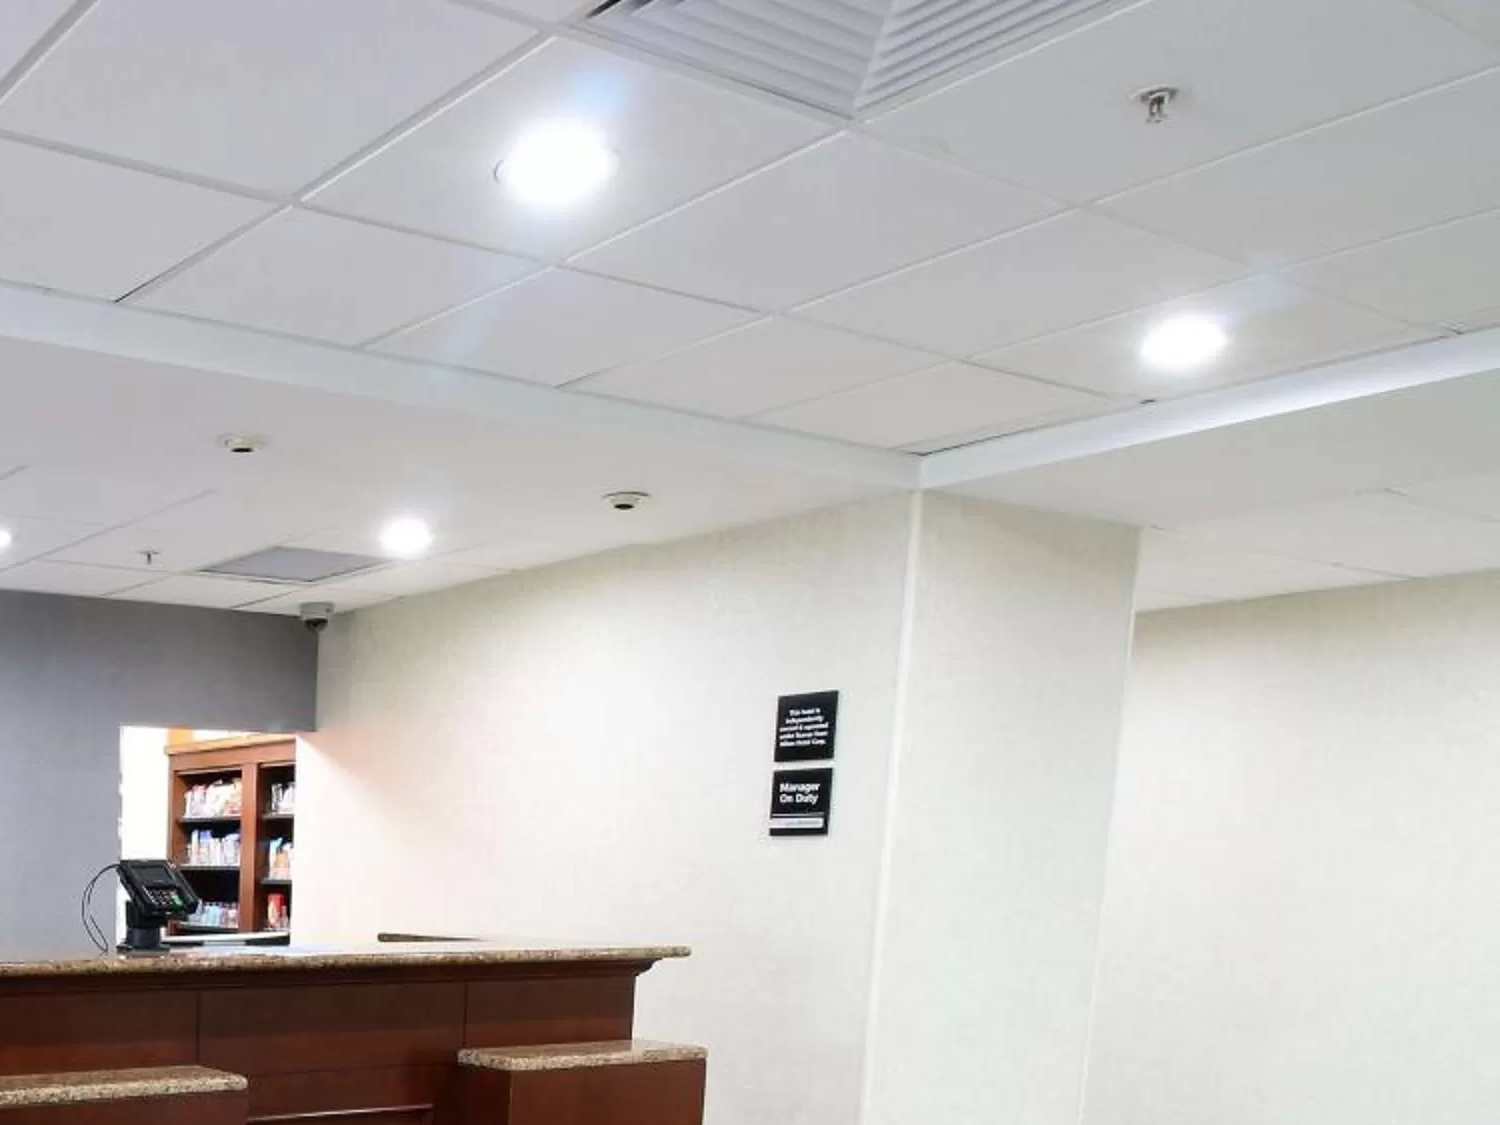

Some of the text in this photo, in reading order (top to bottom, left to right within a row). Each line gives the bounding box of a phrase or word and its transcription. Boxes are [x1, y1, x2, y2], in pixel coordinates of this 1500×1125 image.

[779, 783, 821, 793] Manager
[779, 793, 819, 805] On Duty
